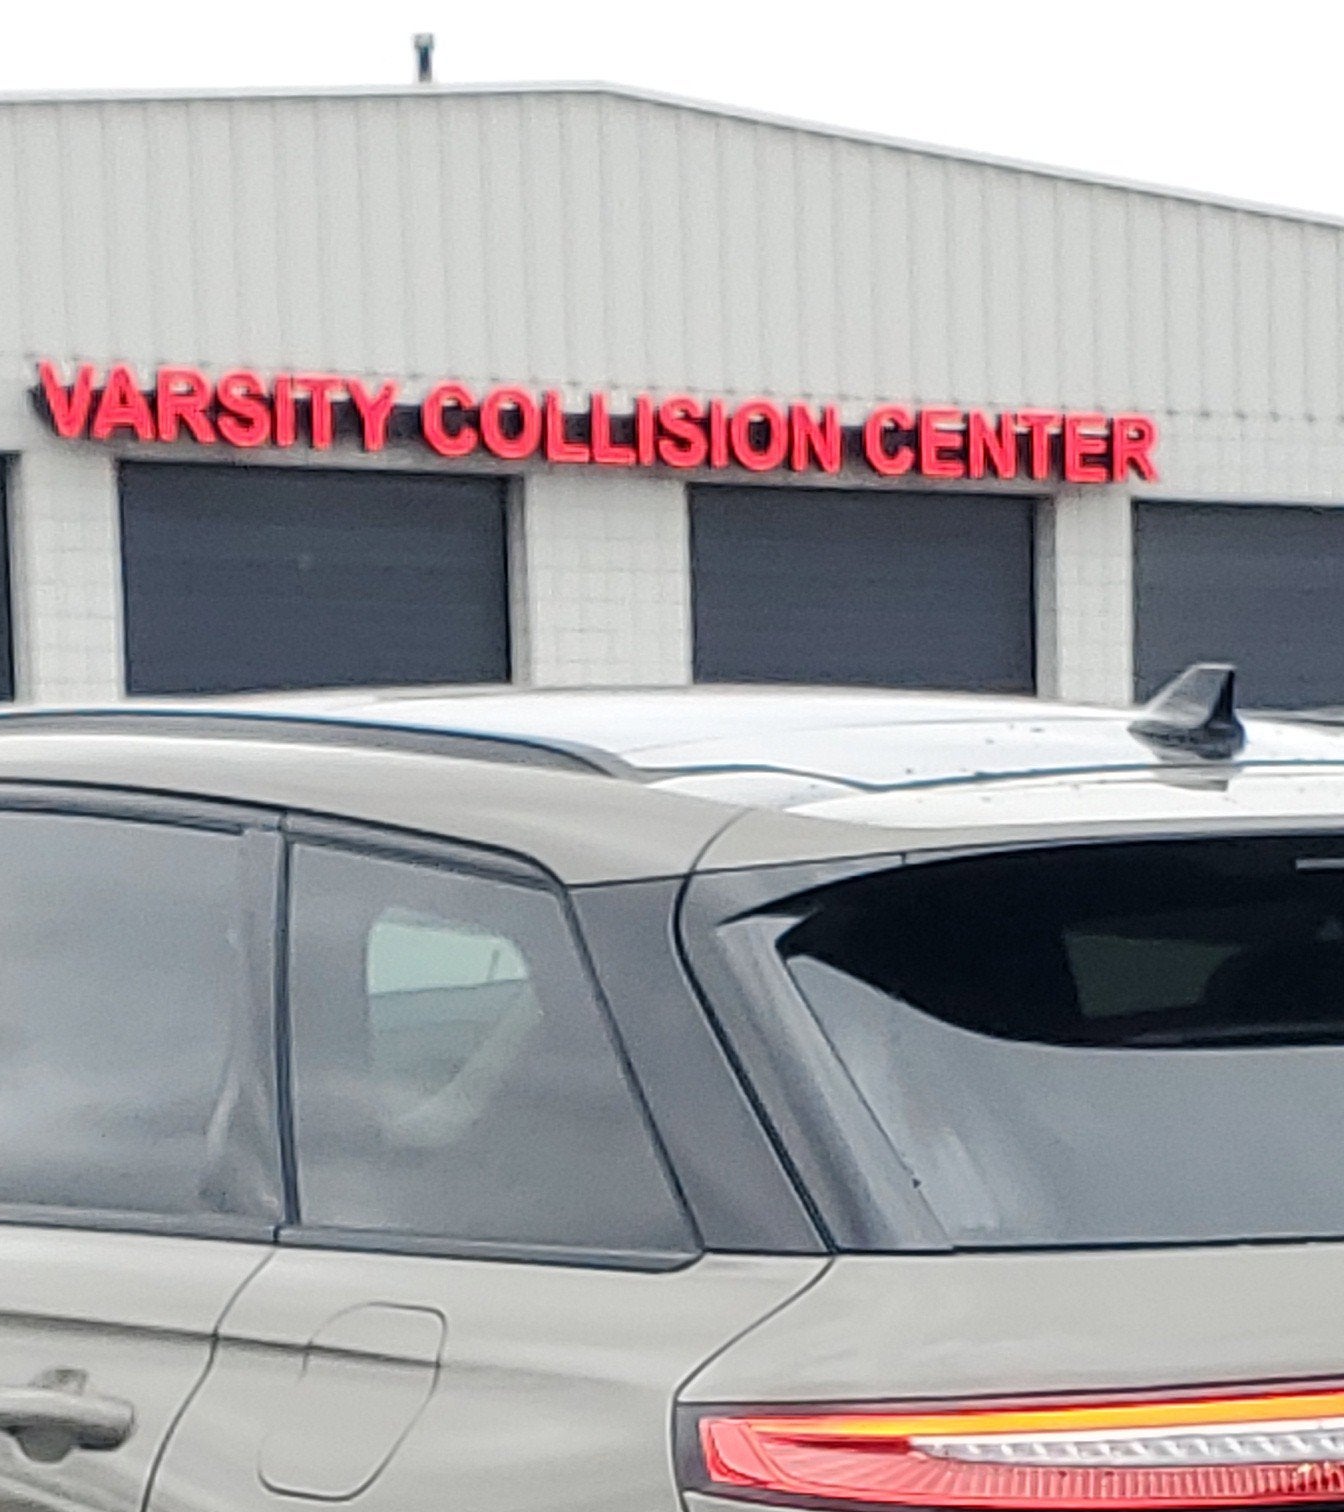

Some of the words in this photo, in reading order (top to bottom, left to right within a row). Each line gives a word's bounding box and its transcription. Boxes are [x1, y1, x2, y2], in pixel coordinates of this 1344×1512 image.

[38, 359, 395, 451] VARSITY
[419, 384, 842, 474] COLLISION
[862, 408, 1158, 485] CENTER
